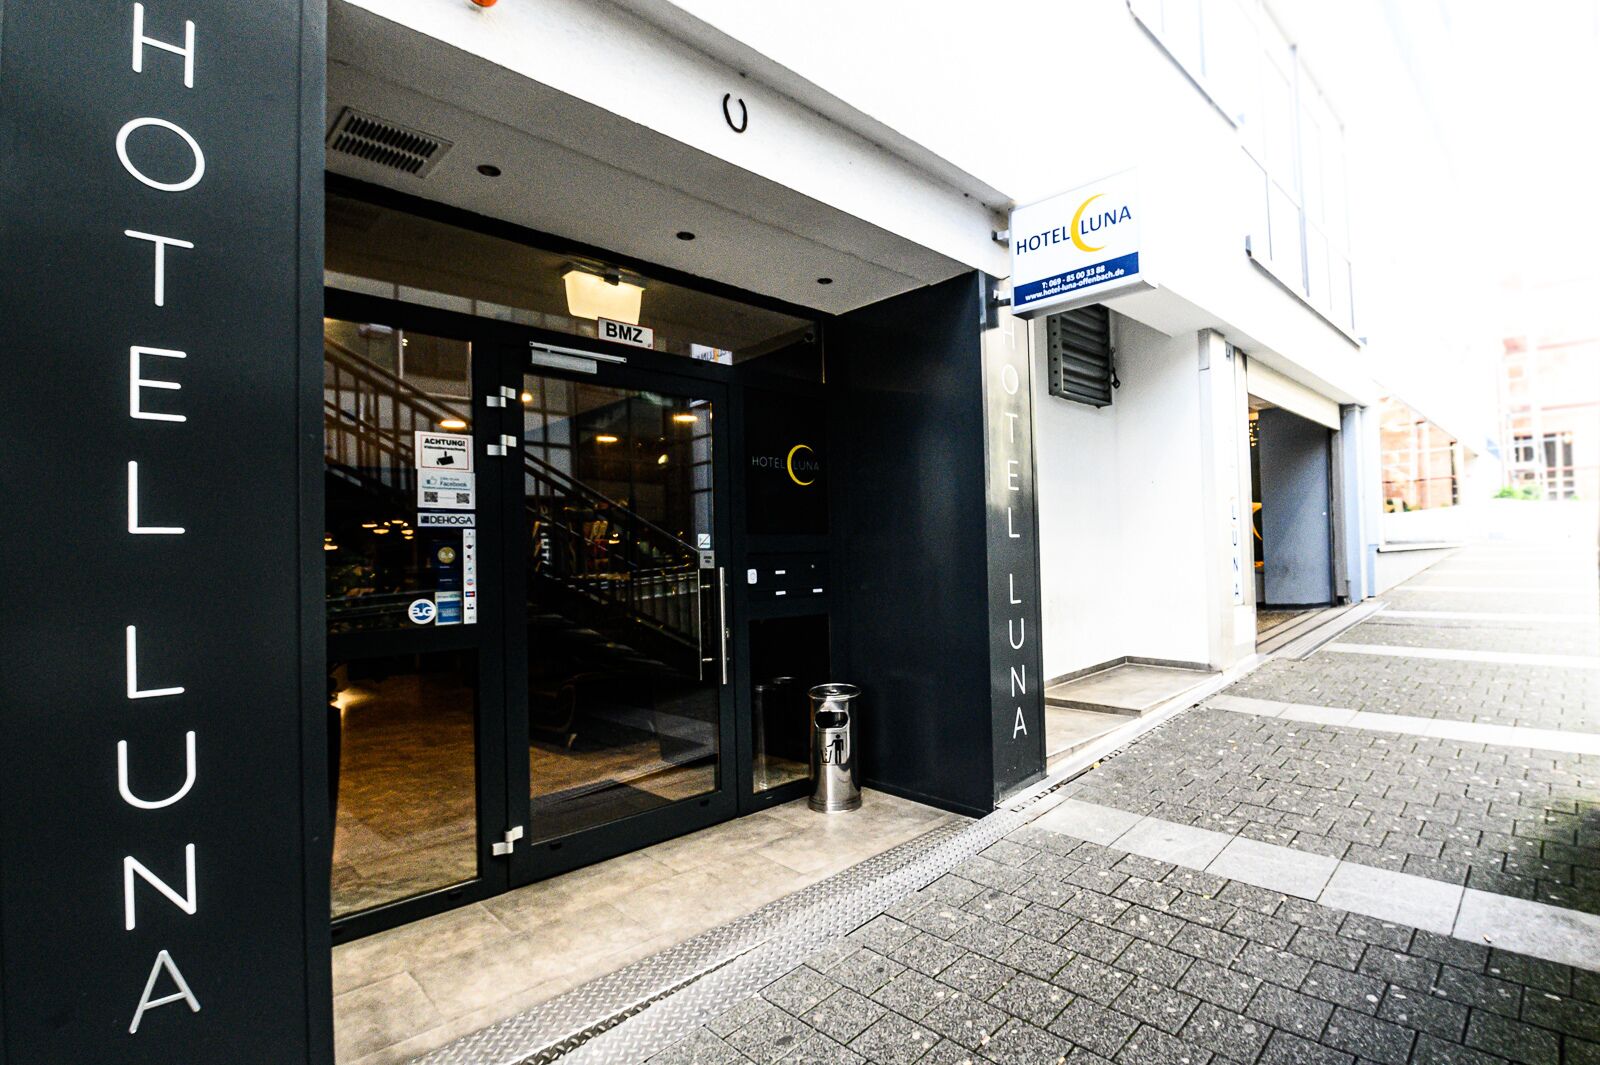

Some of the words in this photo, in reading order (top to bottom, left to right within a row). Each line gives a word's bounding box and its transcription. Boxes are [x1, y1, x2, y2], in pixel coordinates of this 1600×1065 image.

[1016, 226, 1071, 255] HOTEL
[1081, 205, 1132, 235] LUNA
[115, 2, 206, 536] HOTEL
[1025, 268, 1125, 301] www.hotel-luna-offenbach.de
[1042, 281, 1049, 290] T:
[1048, 277, 1062, 288] 069
[1066, 273, 1076, 283] 85
[1075, 270, 1086, 280] 00
[1086, 267, 1095, 277] 33
[1095, 264, 1106, 274] 88
[605, 321, 644, 344] BMZ
[424, 437, 466, 447] ACHTUNG!
[1001, 318, 1021, 539] HOTEL
[751, 455, 786, 469] HOTEL
[792, 460, 820, 471] LUNA
[430, 515, 473, 525] DEHOGA
[1008, 572, 1028, 740] LUNA
[117, 624, 202, 1035] LUNA
